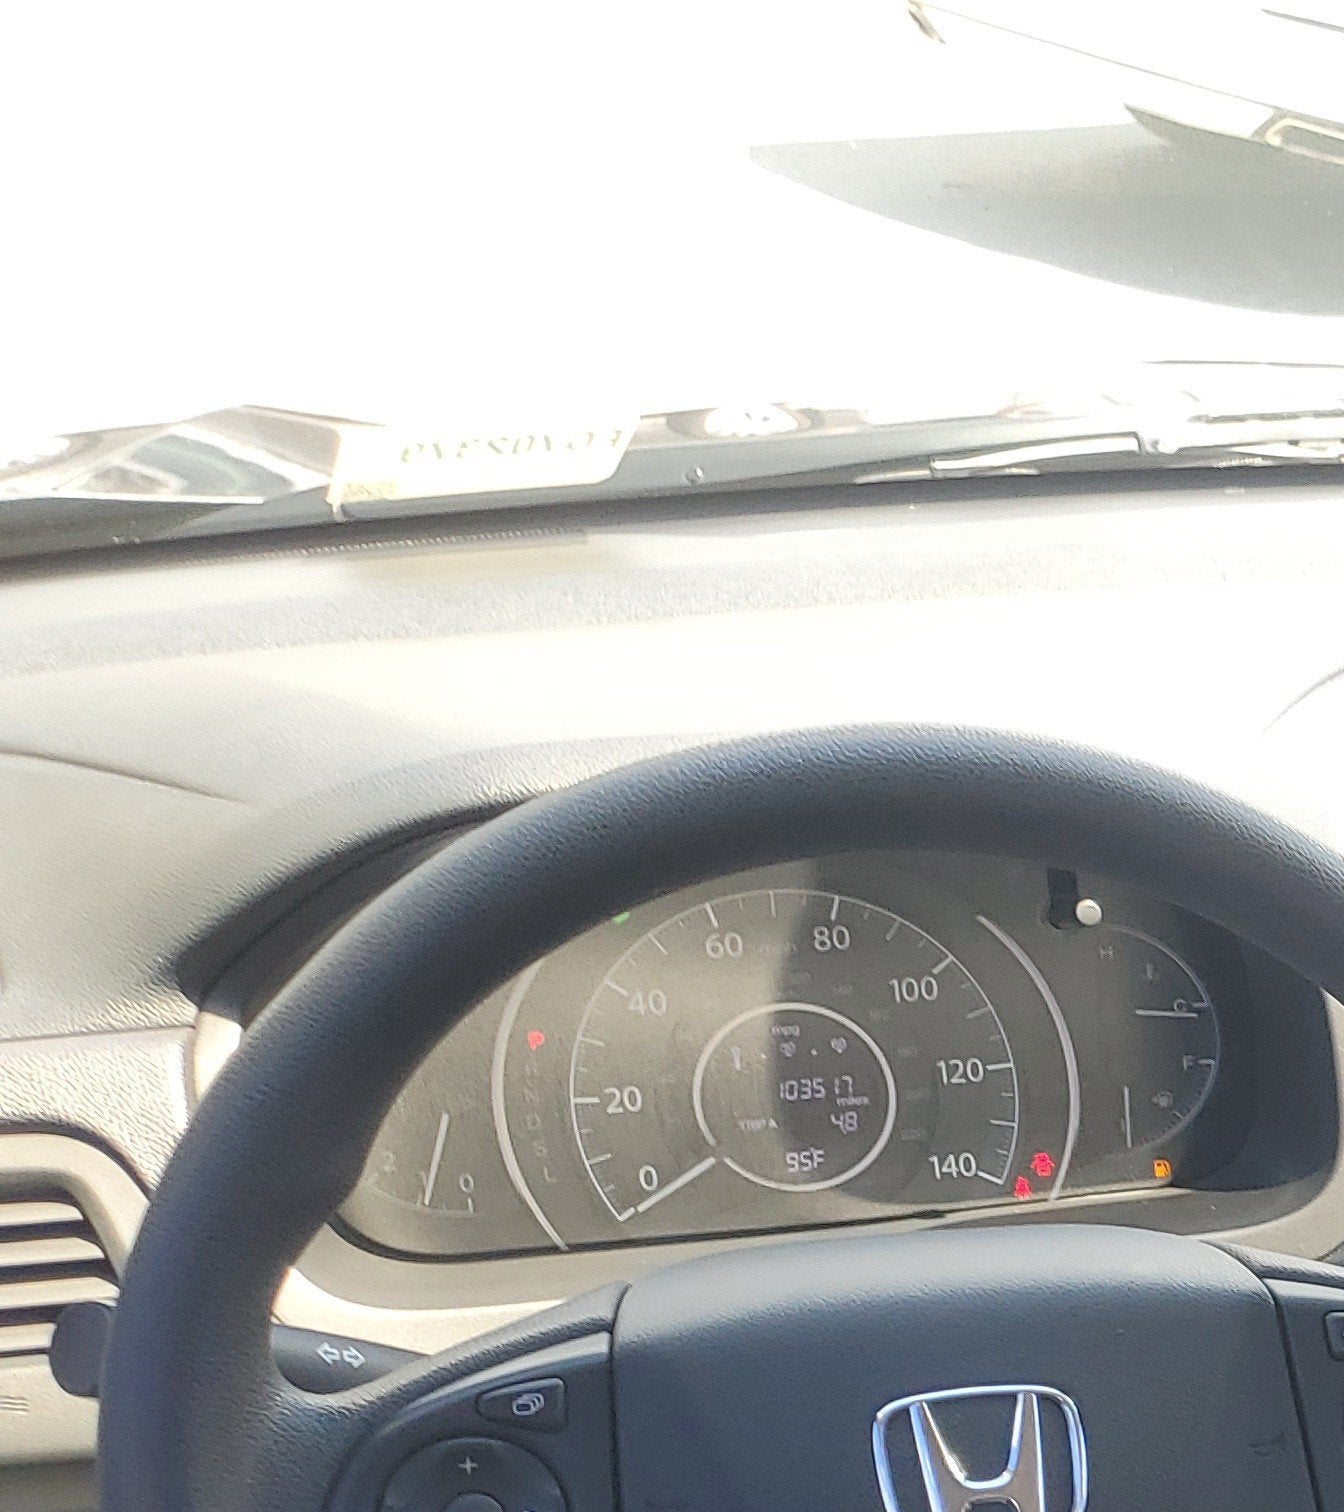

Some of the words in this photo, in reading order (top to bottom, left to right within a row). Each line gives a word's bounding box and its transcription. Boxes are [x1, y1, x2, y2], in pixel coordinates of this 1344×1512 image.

[706, 932, 743, 958] 60
[813, 926, 851, 951] 80
[889, 976, 938, 1002] 100
[628, 989, 667, 1016] 40
[937, 1058, 984, 1085] 120
[605, 1087, 642, 1112] 20
[639, 1165, 658, 1191] 0
[929, 1152, 977, 1179] 140
[459, 1172, 475, 1193] 0
